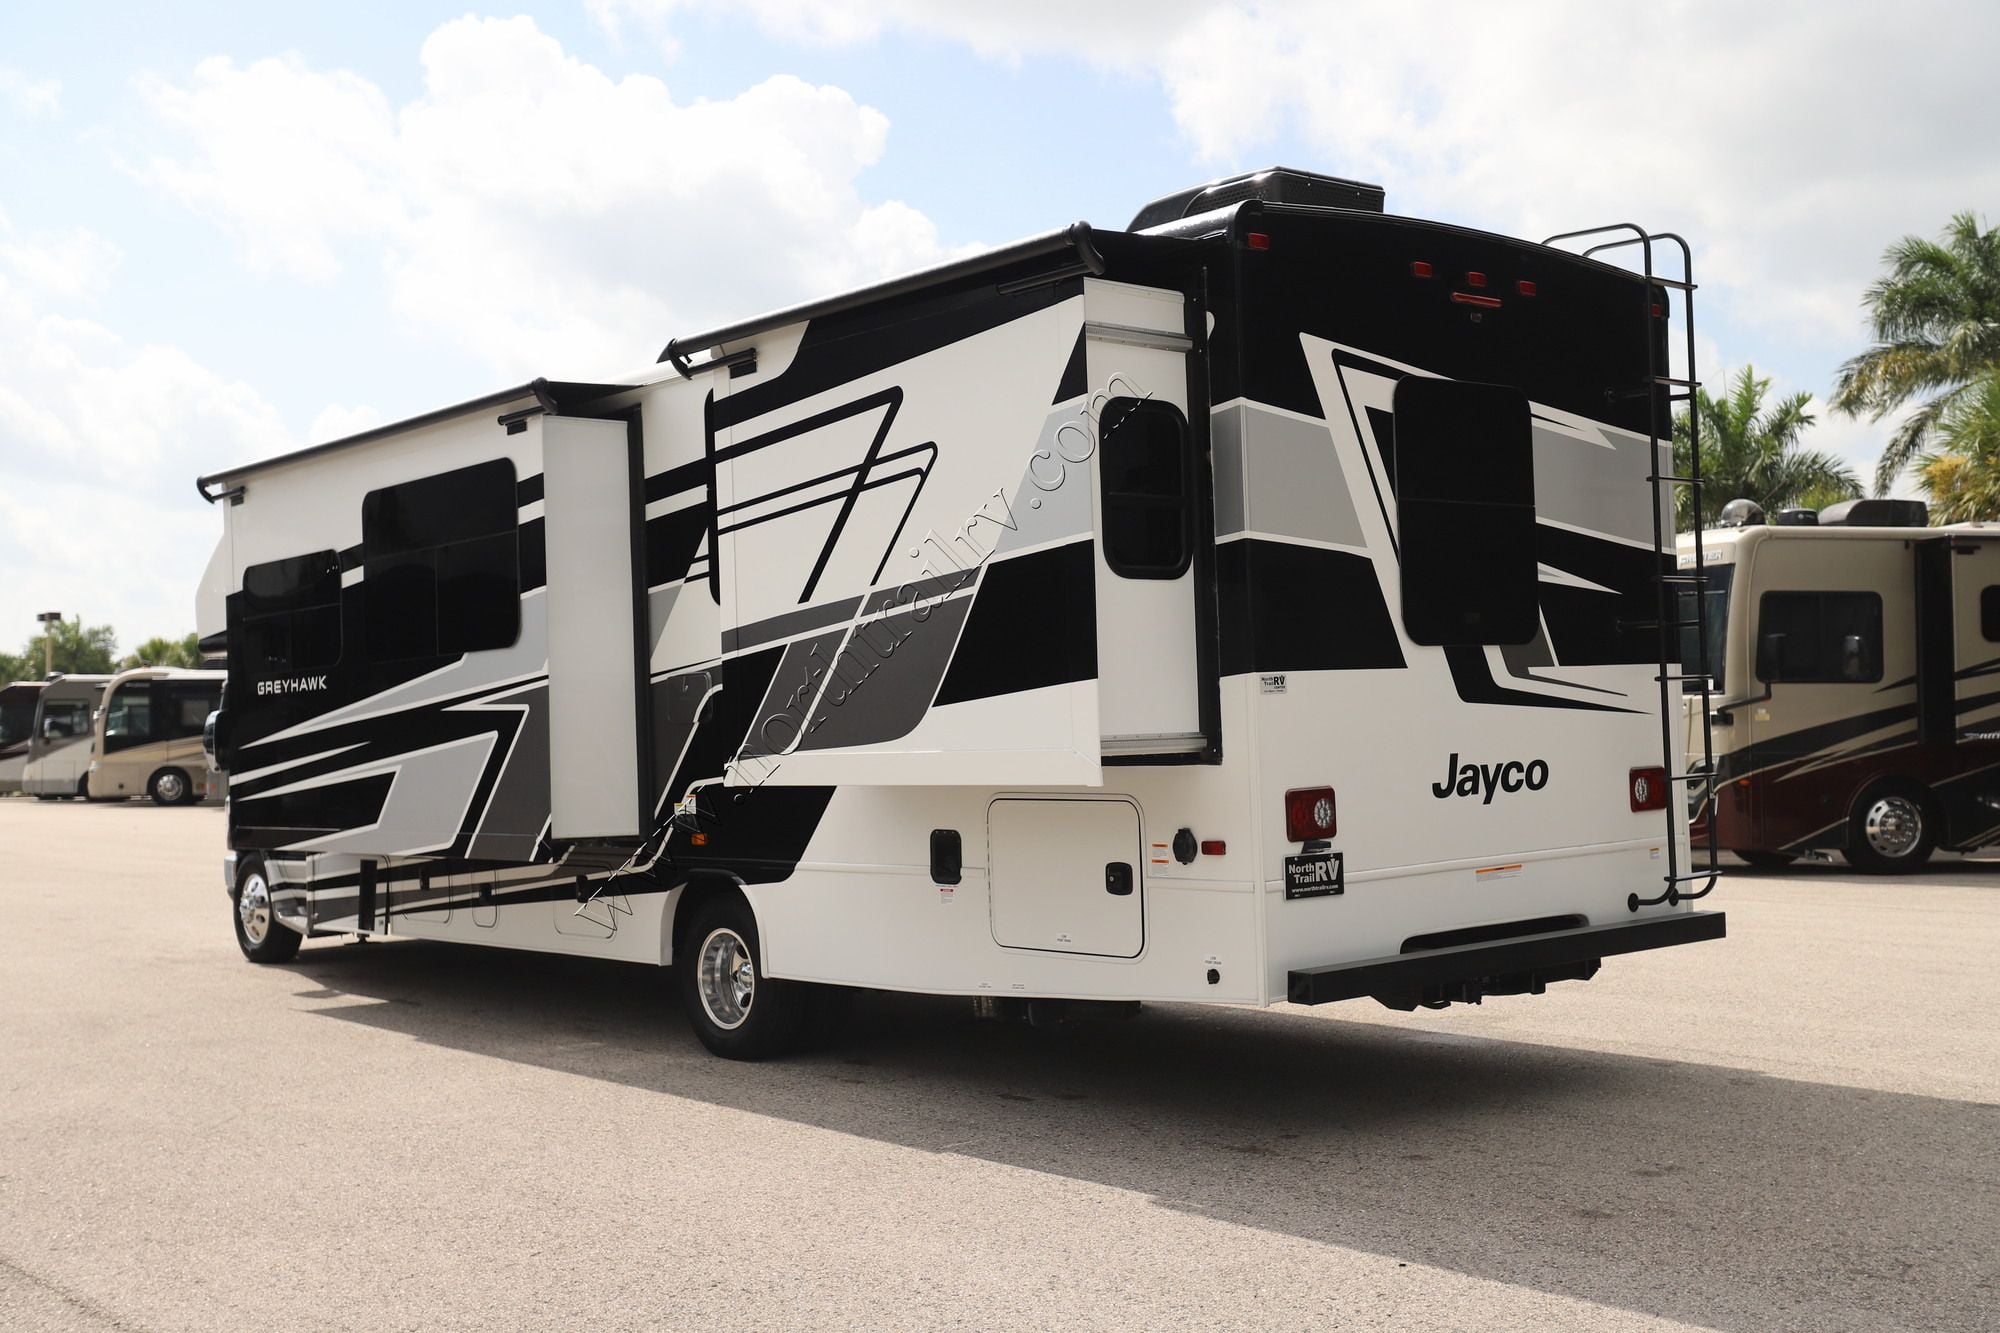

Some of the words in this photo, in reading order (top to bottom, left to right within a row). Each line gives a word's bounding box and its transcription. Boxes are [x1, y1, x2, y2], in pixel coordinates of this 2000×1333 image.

[257, 675, 327, 696] GREYHAWK
[1273, 675, 1285, 686] RV
[1432, 753, 1549, 805] Jayco
[1288, 863, 1315, 874] North
[1315, 858, 1340, 882] RV
[1294, 873, 1315, 883] Trail
